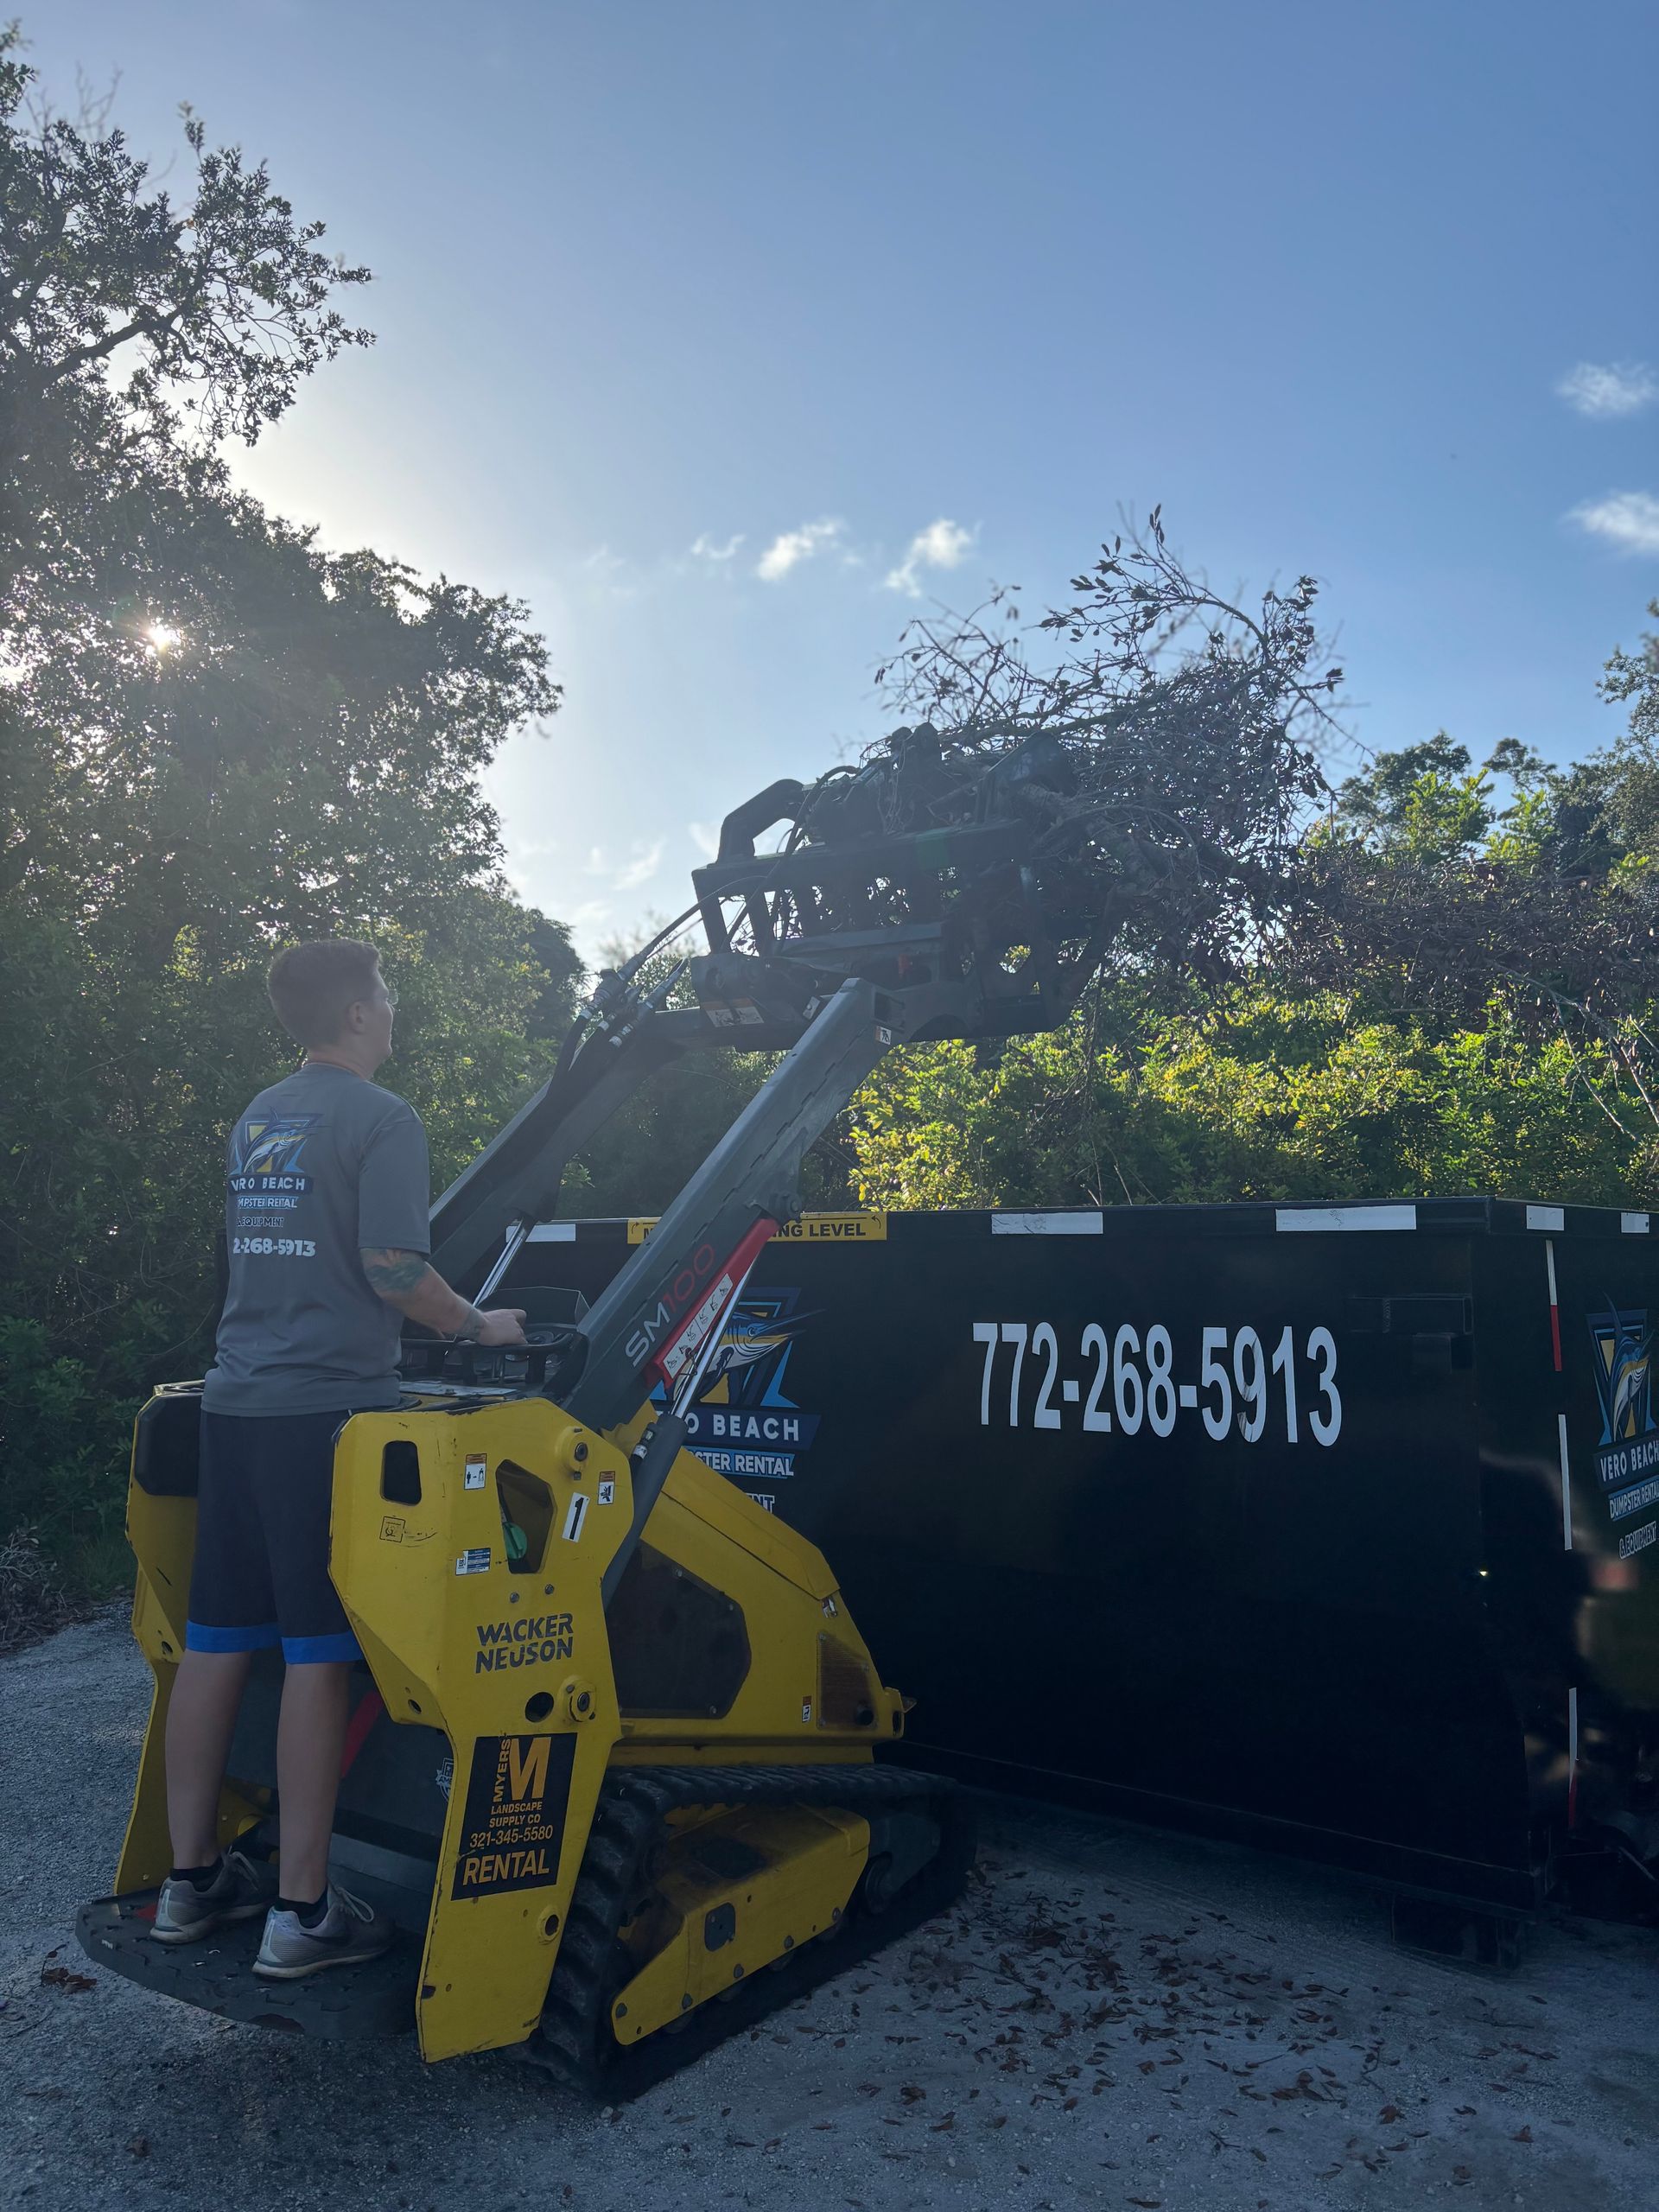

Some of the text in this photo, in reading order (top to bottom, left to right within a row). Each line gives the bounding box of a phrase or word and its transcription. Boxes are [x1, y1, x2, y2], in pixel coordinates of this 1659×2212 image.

[231, 1177, 305, 1192] VRO BEACH
[809, 1223, 867, 1237] LEVEL
[625, 1243, 715, 1368] SM100
[973, 1321, 1342, 1446] 772-268-5913
[713, 1414, 799, 1441] BEACH
[735, 1454, 794, 1477] RENTAL
[1600, 1451, 1627, 1482] VERO
[1610, 1489, 1641, 1518] DUMPSTER
[569, 1497, 585, 1541] 1
[477, 1612, 574, 1646] WACKER
[475, 1636, 574, 1674] NEUSON
[493, 1738, 512, 1802] MYERS
[489, 1814, 541, 1828] SUPPLY CO
[491, 1802, 543, 1815] LANDSCAPE
[469, 1824, 553, 1848] 321-345-5580
[462, 1848, 550, 1885] RENTAL
